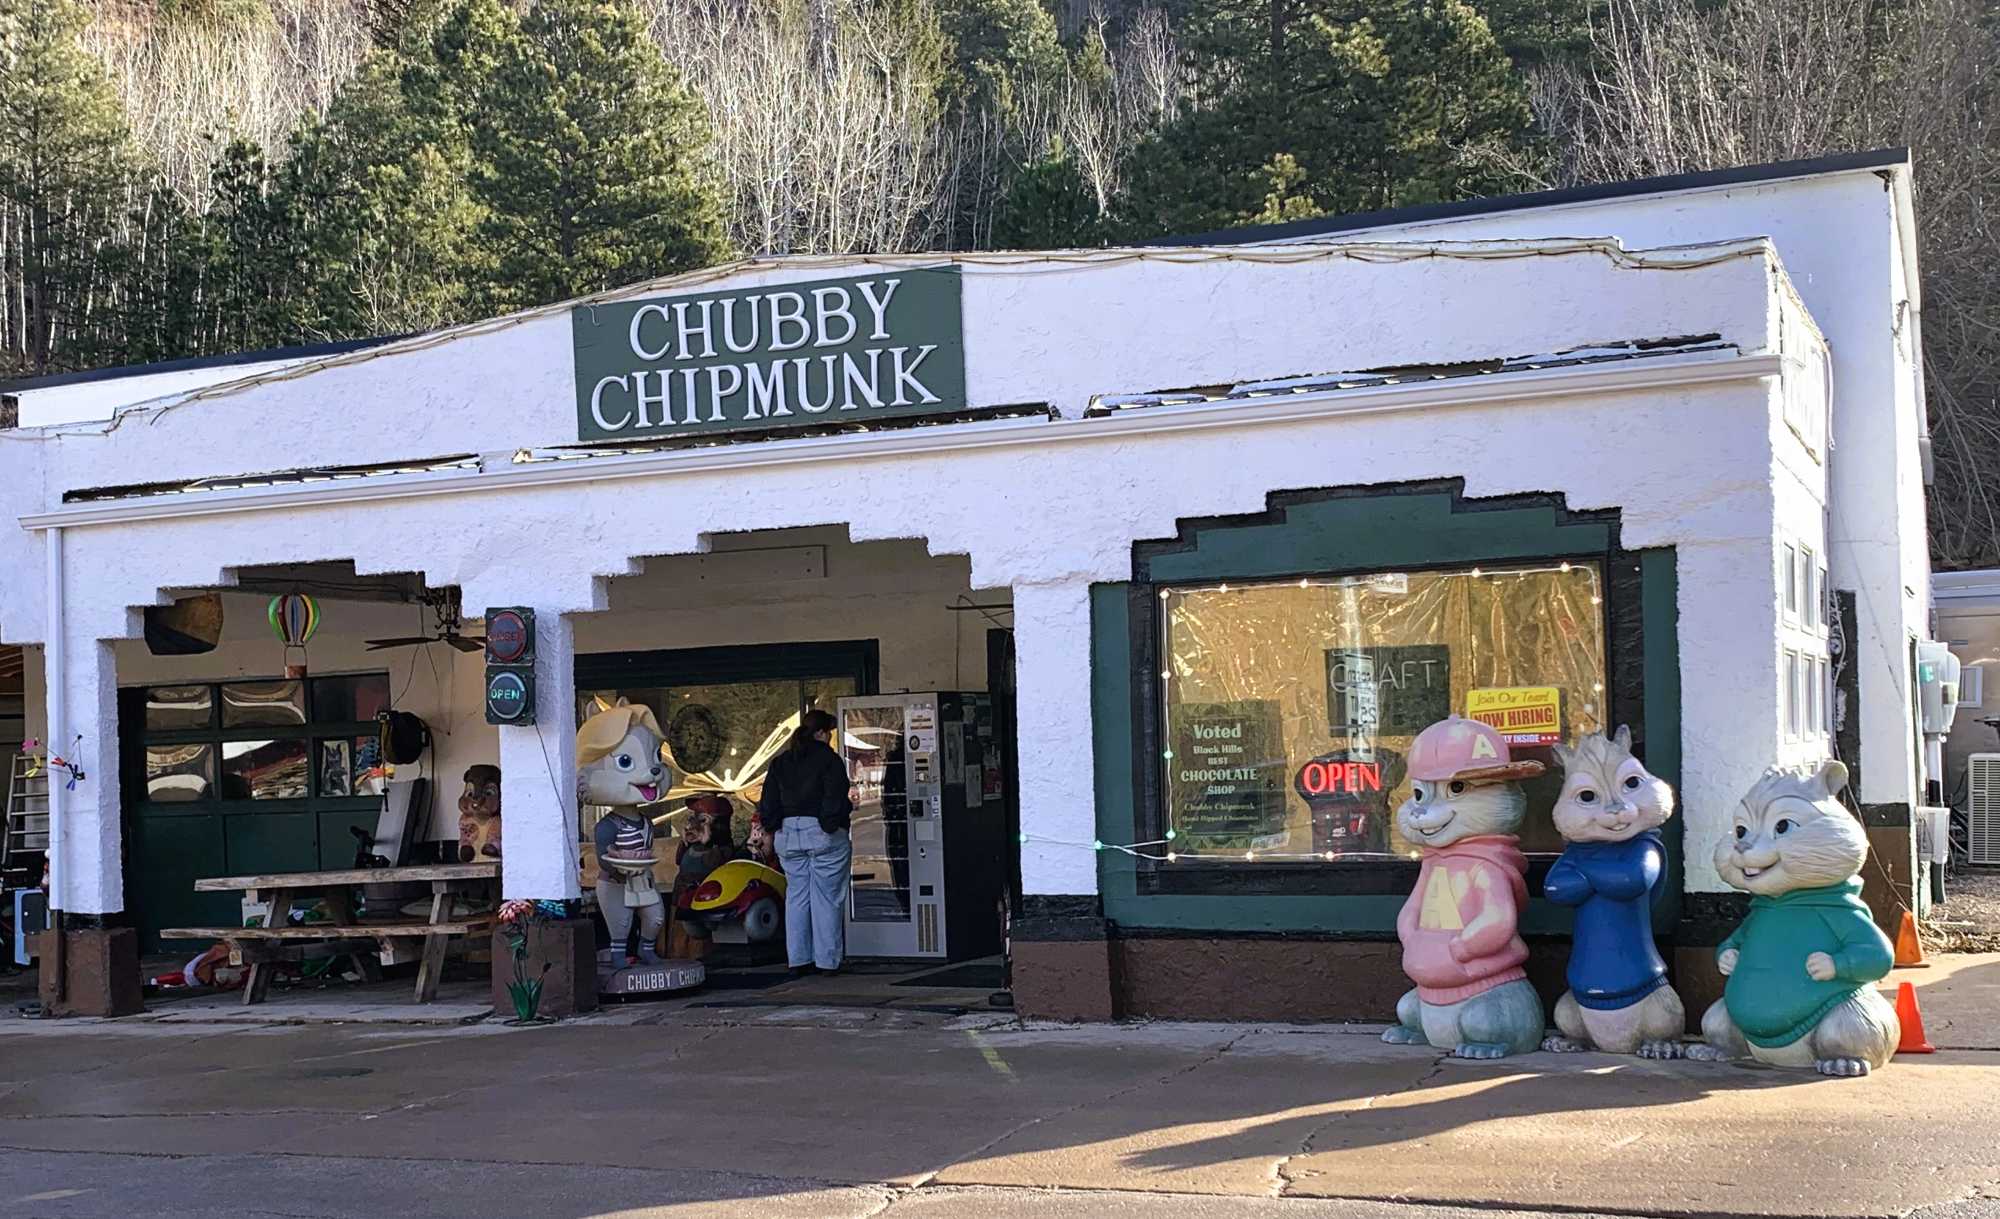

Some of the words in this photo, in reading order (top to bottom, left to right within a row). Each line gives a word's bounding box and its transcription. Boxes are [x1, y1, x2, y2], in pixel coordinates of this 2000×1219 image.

[629, 279, 901, 362] CHUBBY
[591, 344, 942, 432] CHIPMUNK
[490, 689, 520, 700] OPEN
[1507, 707, 1553, 727] HIRING
[1193, 723, 1242, 739] Voted
[1513, 733, 1540, 743] INSIDE
[1193, 745, 1219, 754] Black
[1221, 744, 1243, 753] Hills
[1471, 734, 1498, 760] A
[1207, 757, 1228, 765] BEST
[1180, 768, 1258, 782] CHOCOLATE
[1303, 763, 1381, 793] OPEN
[1207, 785, 1235, 795] SHOP
[627, 972, 671, 990] CHUBBY
